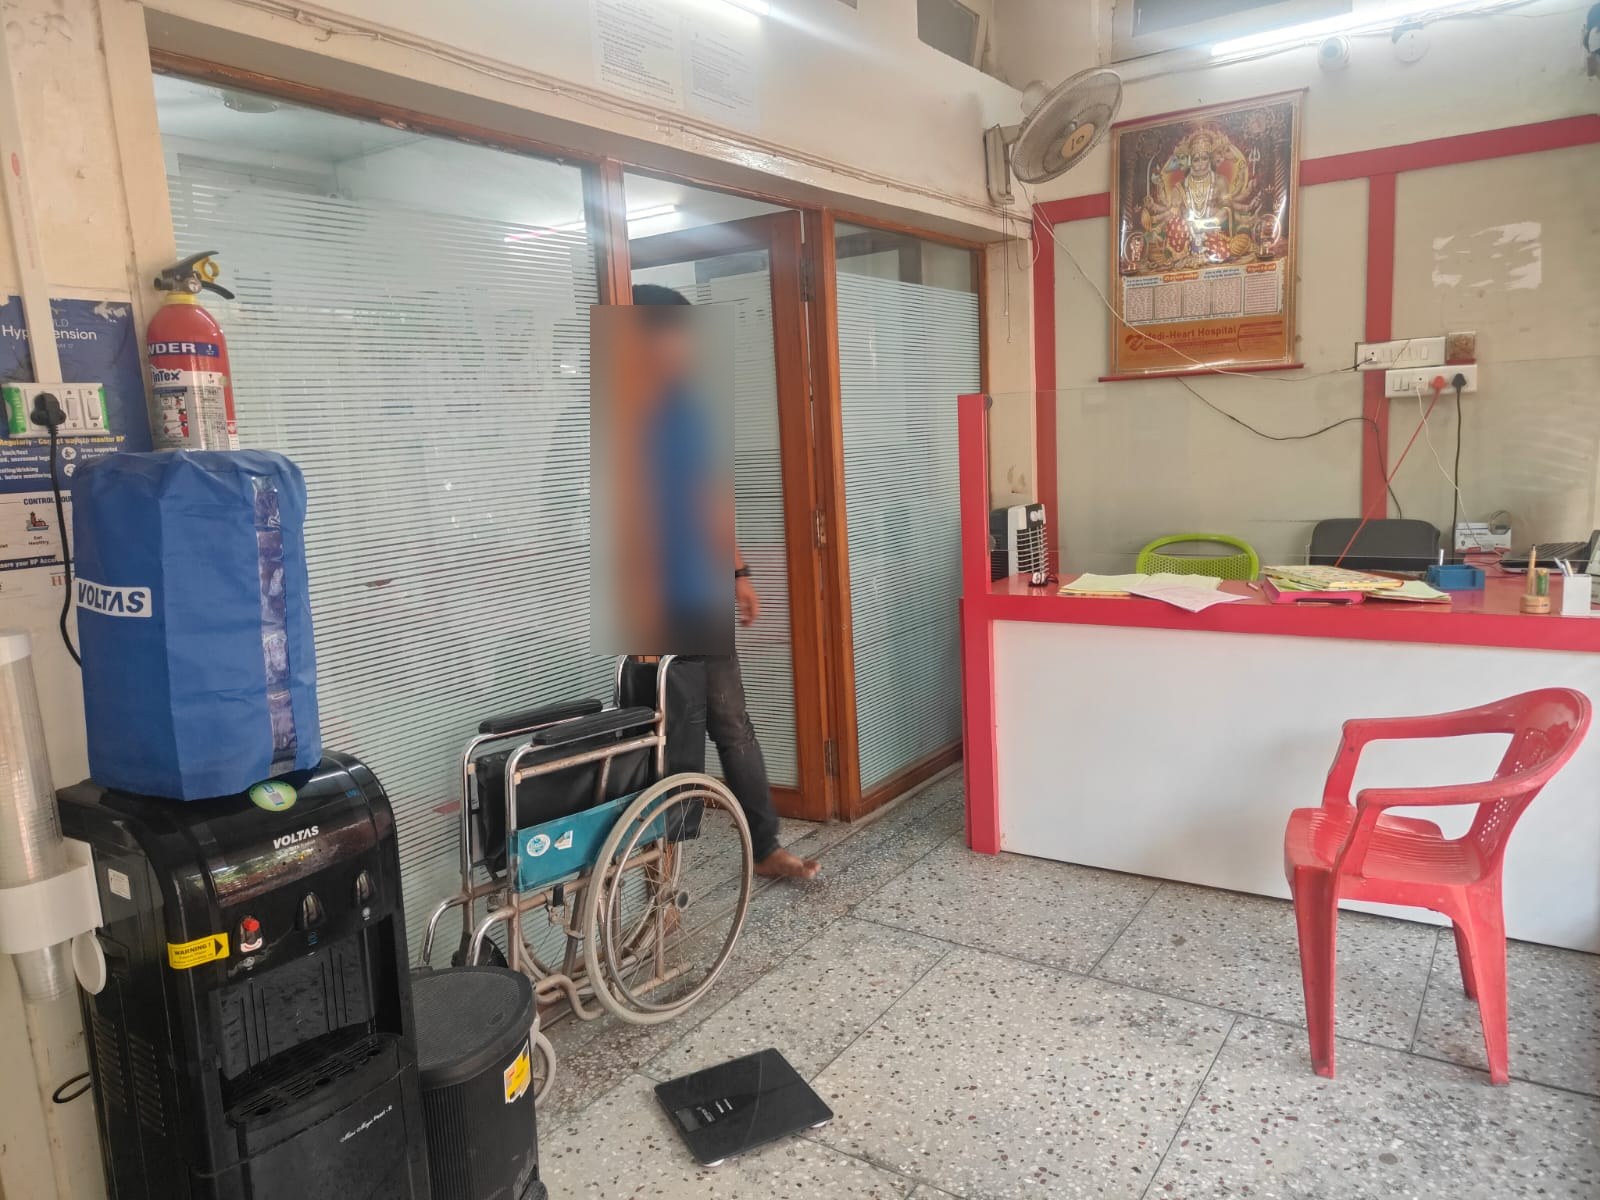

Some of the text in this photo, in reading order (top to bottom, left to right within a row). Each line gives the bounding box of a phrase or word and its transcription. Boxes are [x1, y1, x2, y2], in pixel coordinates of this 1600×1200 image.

[1198, 325, 1236, 337] Hospital
[78, 582, 145, 613] VOLTAS
[273, 825, 319, 849] VOLTAS
